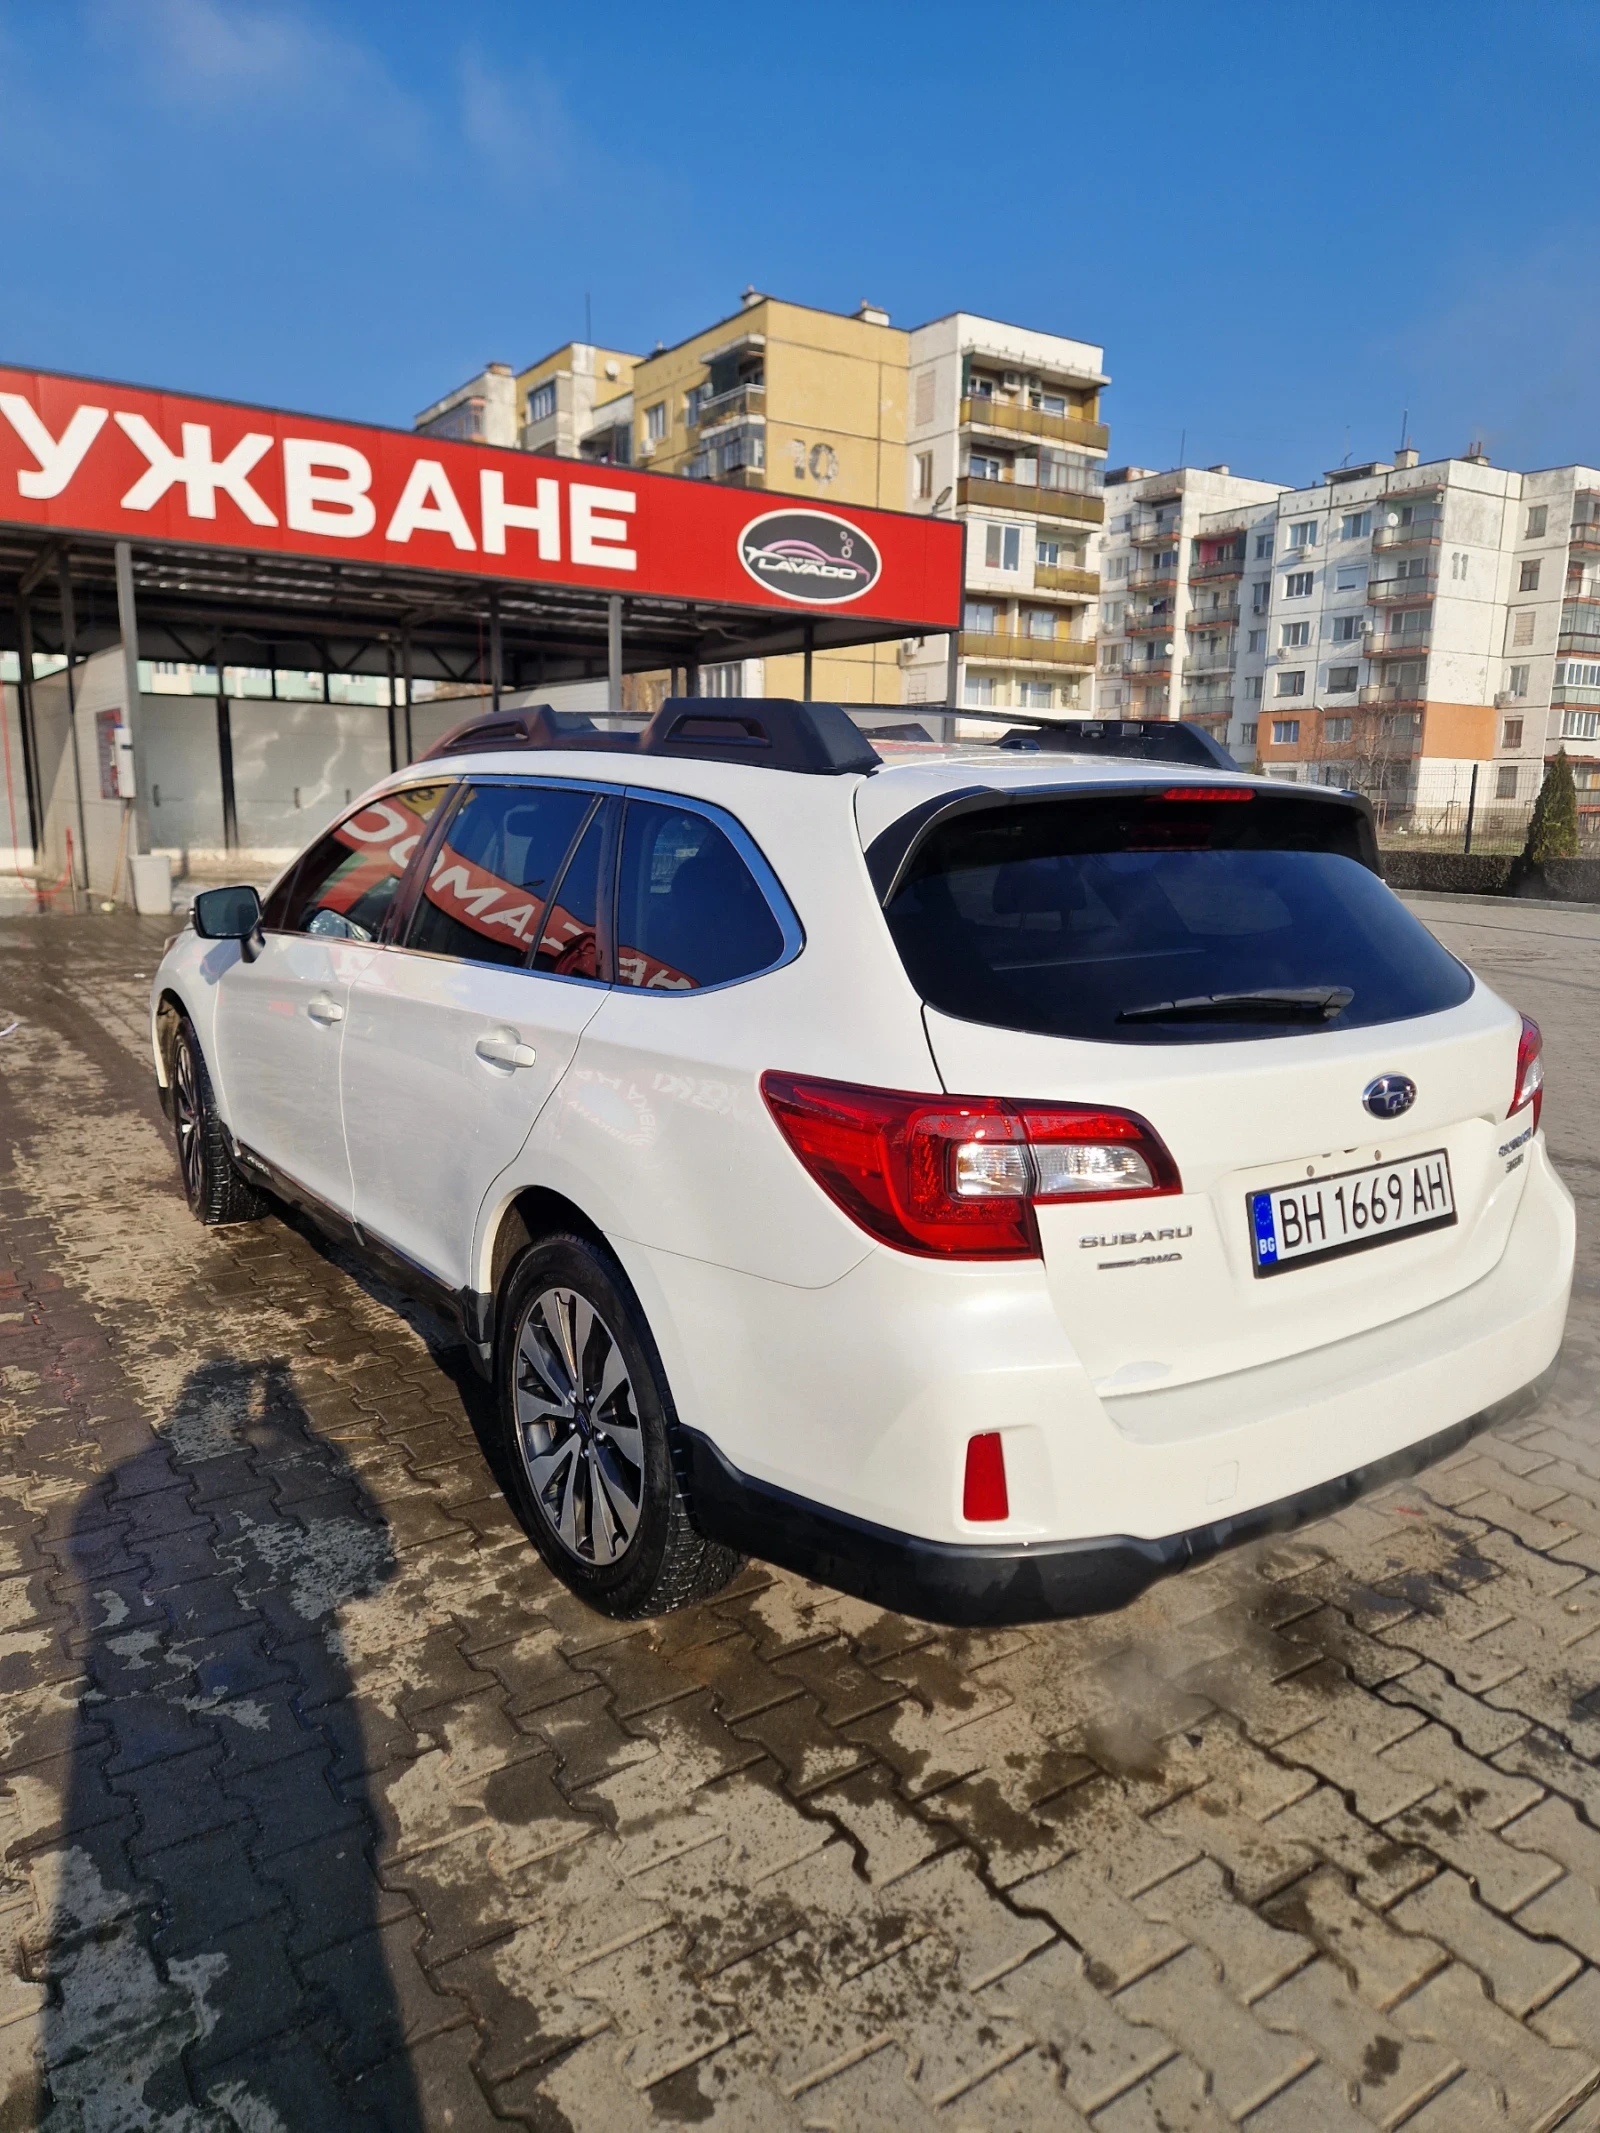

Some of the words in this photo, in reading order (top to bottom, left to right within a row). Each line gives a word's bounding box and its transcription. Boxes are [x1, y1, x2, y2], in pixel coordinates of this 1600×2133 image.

[0, 391, 638, 572] УЖВАНЕ
[758, 557, 858, 581] LAVADO
[1451, 551, 1469, 581] 11
[1279, 1191, 1326, 1249] BH
[1335, 1173, 1403, 1234] 1669
[1412, 1161, 1446, 1215] AH
[1079, 1225, 1193, 1248] SUBARU
[1258, 1237, 1276, 1255] BG
[1137, 1252, 1183, 1265] AWD
